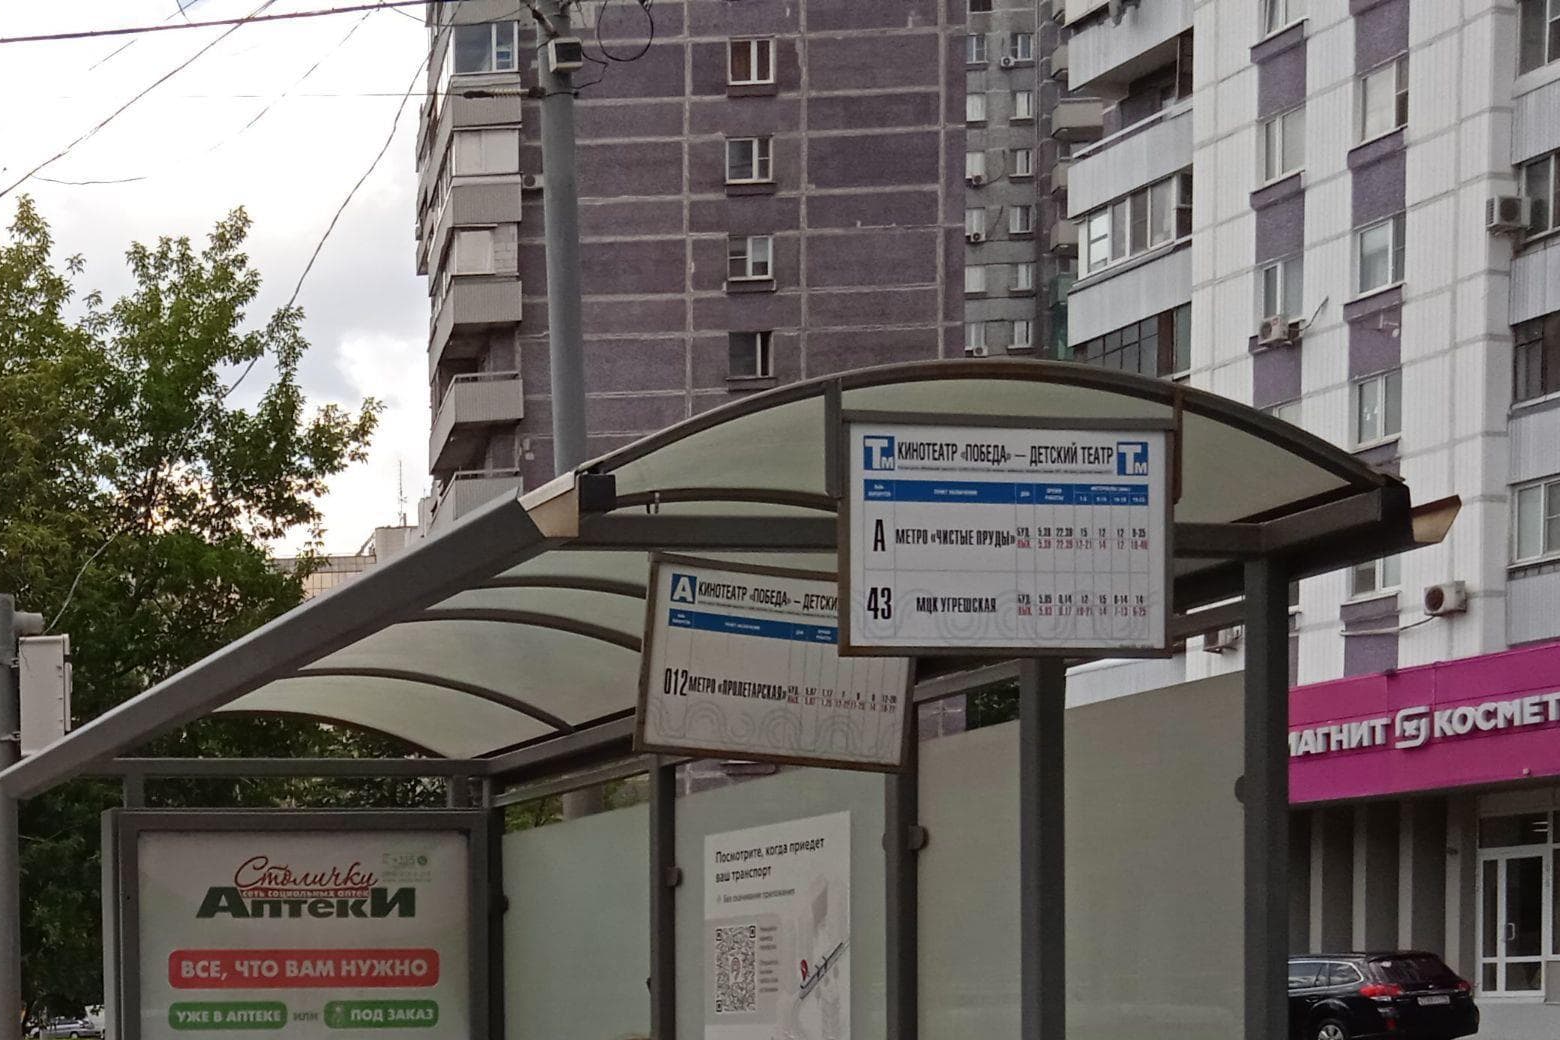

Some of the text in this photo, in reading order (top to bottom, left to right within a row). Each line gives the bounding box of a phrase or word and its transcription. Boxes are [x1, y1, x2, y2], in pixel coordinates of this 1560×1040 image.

[897, 442, 1114, 467] КИНОТЕАТР «ПОБЕДА» ДЕТСКИЙ ТЕАТР
[895, 528, 1015, 550] МЕТРО «ЧИСТЫЕ ПРУДЫ»
[698, 582, 748, 600] КИНОТЕАТР
[750, 588, 791, 607] «ПОБЕДА»
[803, 593, 838, 611] ДЕТСКИ
[867, 587, 892, 620] 43
[916, 597, 996, 614] МЦК УГРЕШСКАЯ
[664, 668, 689, 696] 012
[689, 675, 716, 694] МЕТРО
[718, 679, 787, 701] «ПРОЛЕТАРСКАЯ»
[715, 838, 825, 863] Посмотрите, когда приедет
[235, 855, 378, 889] Столички
[715, 866, 771, 883] ваш транспорт
[243, 889, 370, 899] сеть социальных аптек
[180, 959, 428, 980] ВСЕ, ЧТО ВАМ НУЖНО
[176, 1010, 281, 1023] УЖЕ В АПТЕКЕ
[350, 1008, 434, 1023] ПОД ЗАКАЗ
